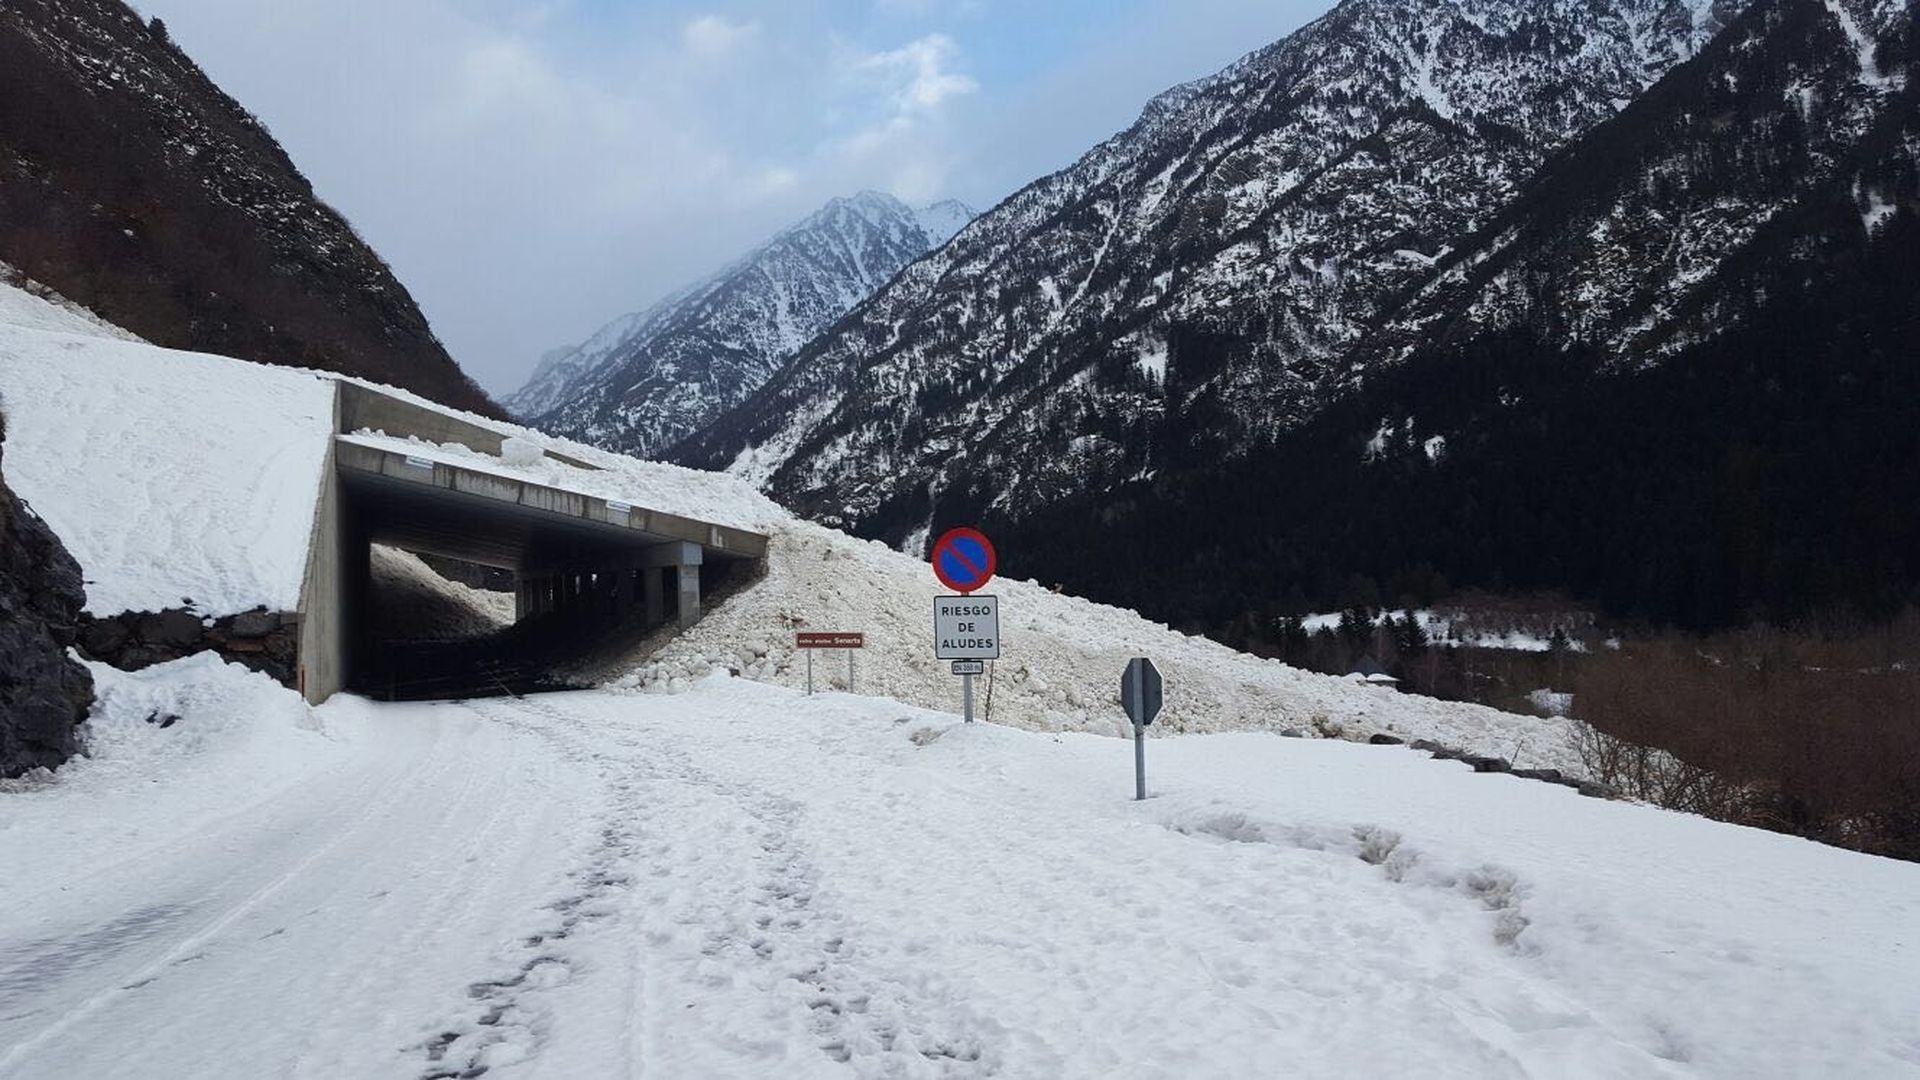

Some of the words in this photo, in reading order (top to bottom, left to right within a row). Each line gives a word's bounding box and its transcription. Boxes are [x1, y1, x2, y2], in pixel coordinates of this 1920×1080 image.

[942, 606, 991, 616] RIESGO
[958, 622, 975, 632] DE
[942, 638, 993, 648] ALUDES
